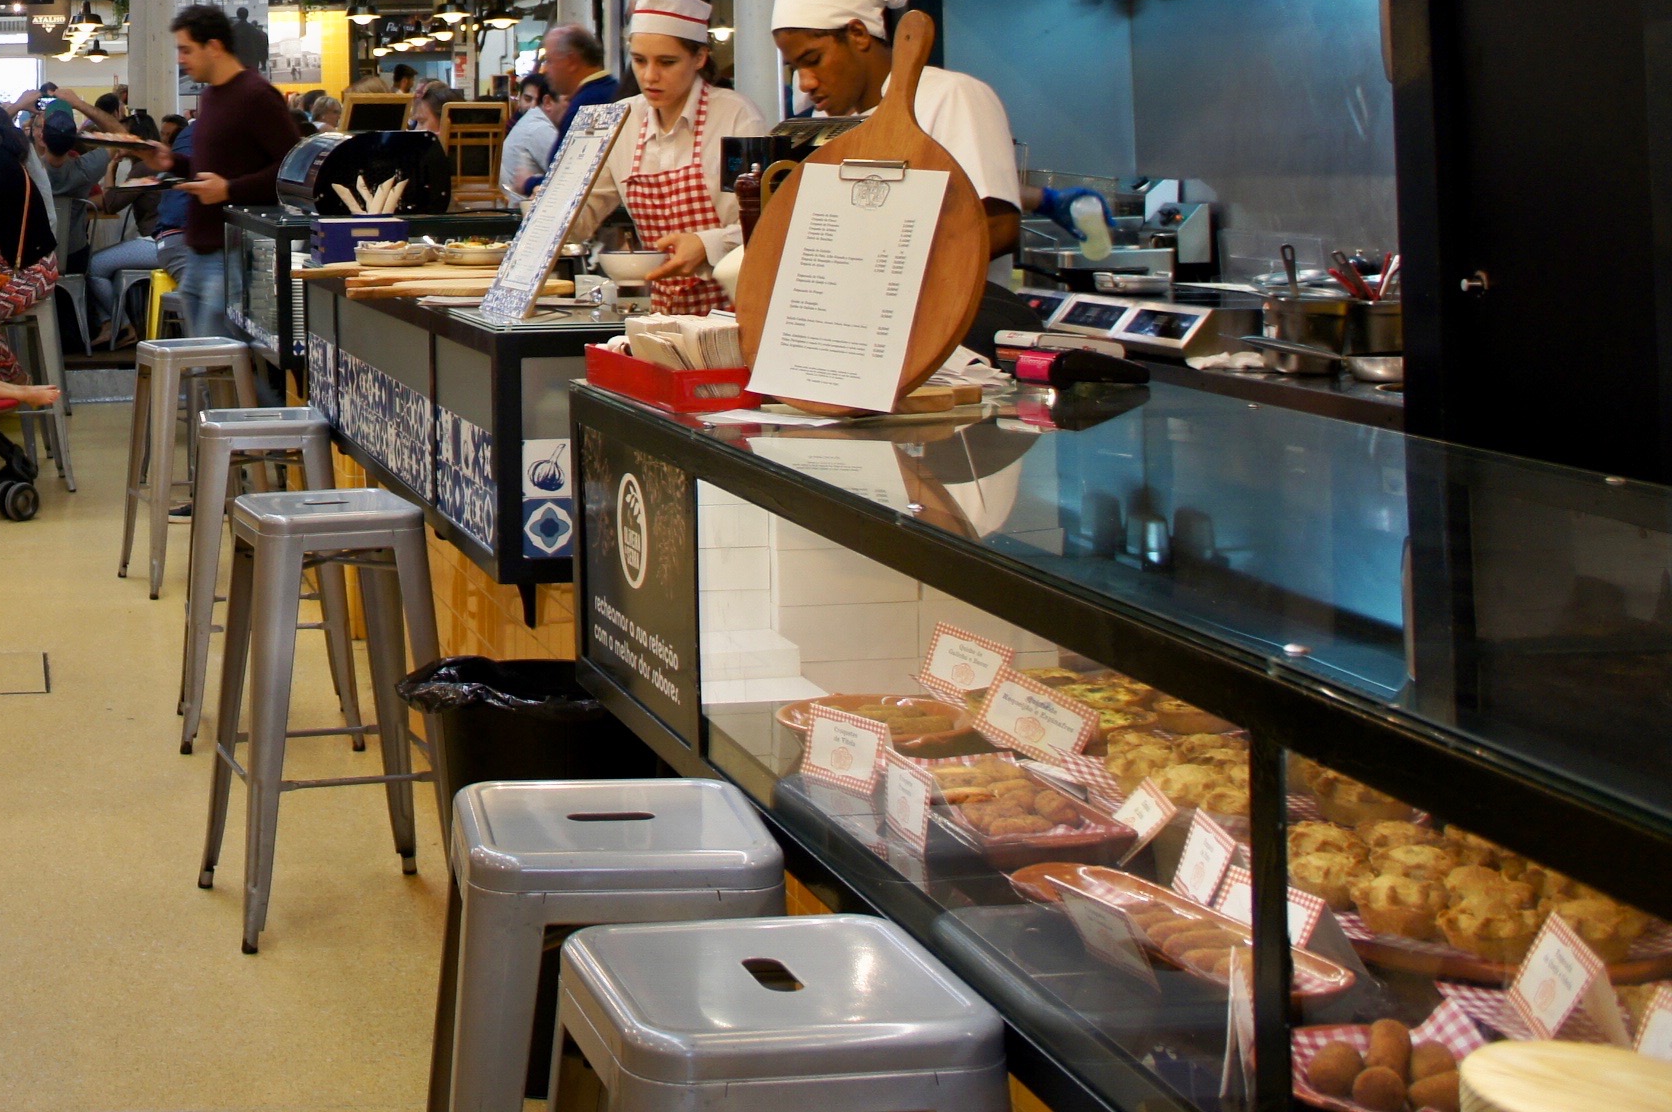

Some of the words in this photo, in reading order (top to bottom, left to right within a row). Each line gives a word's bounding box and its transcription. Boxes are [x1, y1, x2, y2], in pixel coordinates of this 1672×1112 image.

[593, 623, 608, 647] com
[614, 639, 637, 670] melhor
[648, 634, 679, 671] refeição
